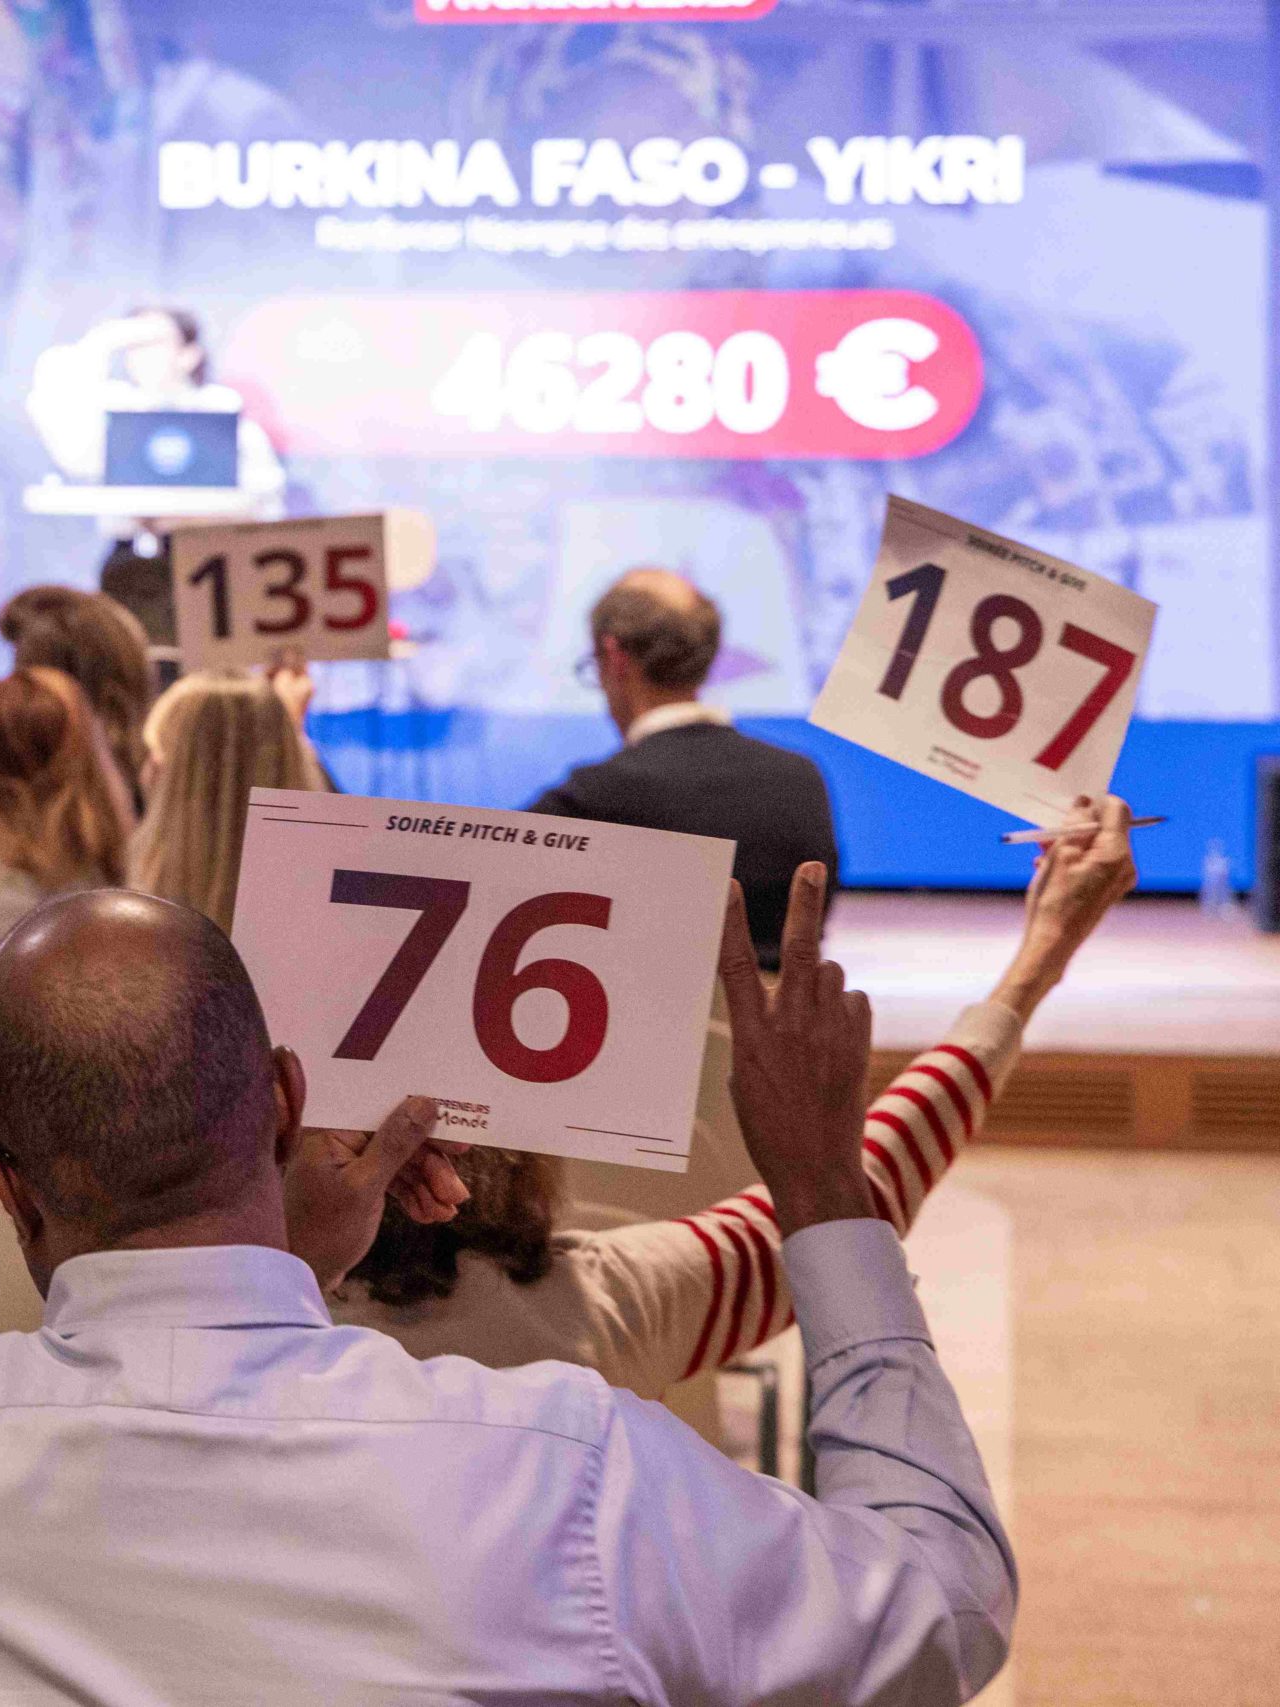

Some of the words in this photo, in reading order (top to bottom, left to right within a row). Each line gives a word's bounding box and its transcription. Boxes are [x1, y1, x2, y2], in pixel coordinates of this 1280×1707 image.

[157, 137, 521, 210] BURKINA
[530, 135, 749, 208] FASO
[806, 134, 1025, 205] YIKRI
[430, 329, 789, 434] 46280
[815, 317, 938, 431] €
[188, 544, 378, 638] 135
[876, 561, 1137, 772] 187
[386, 815, 456, 836] SOIRÉE
[459, 822, 519, 843] PITCH
[523, 829, 538, 845] &
[543, 832, 590, 851] GIVE
[329, 868, 613, 1084] 76
